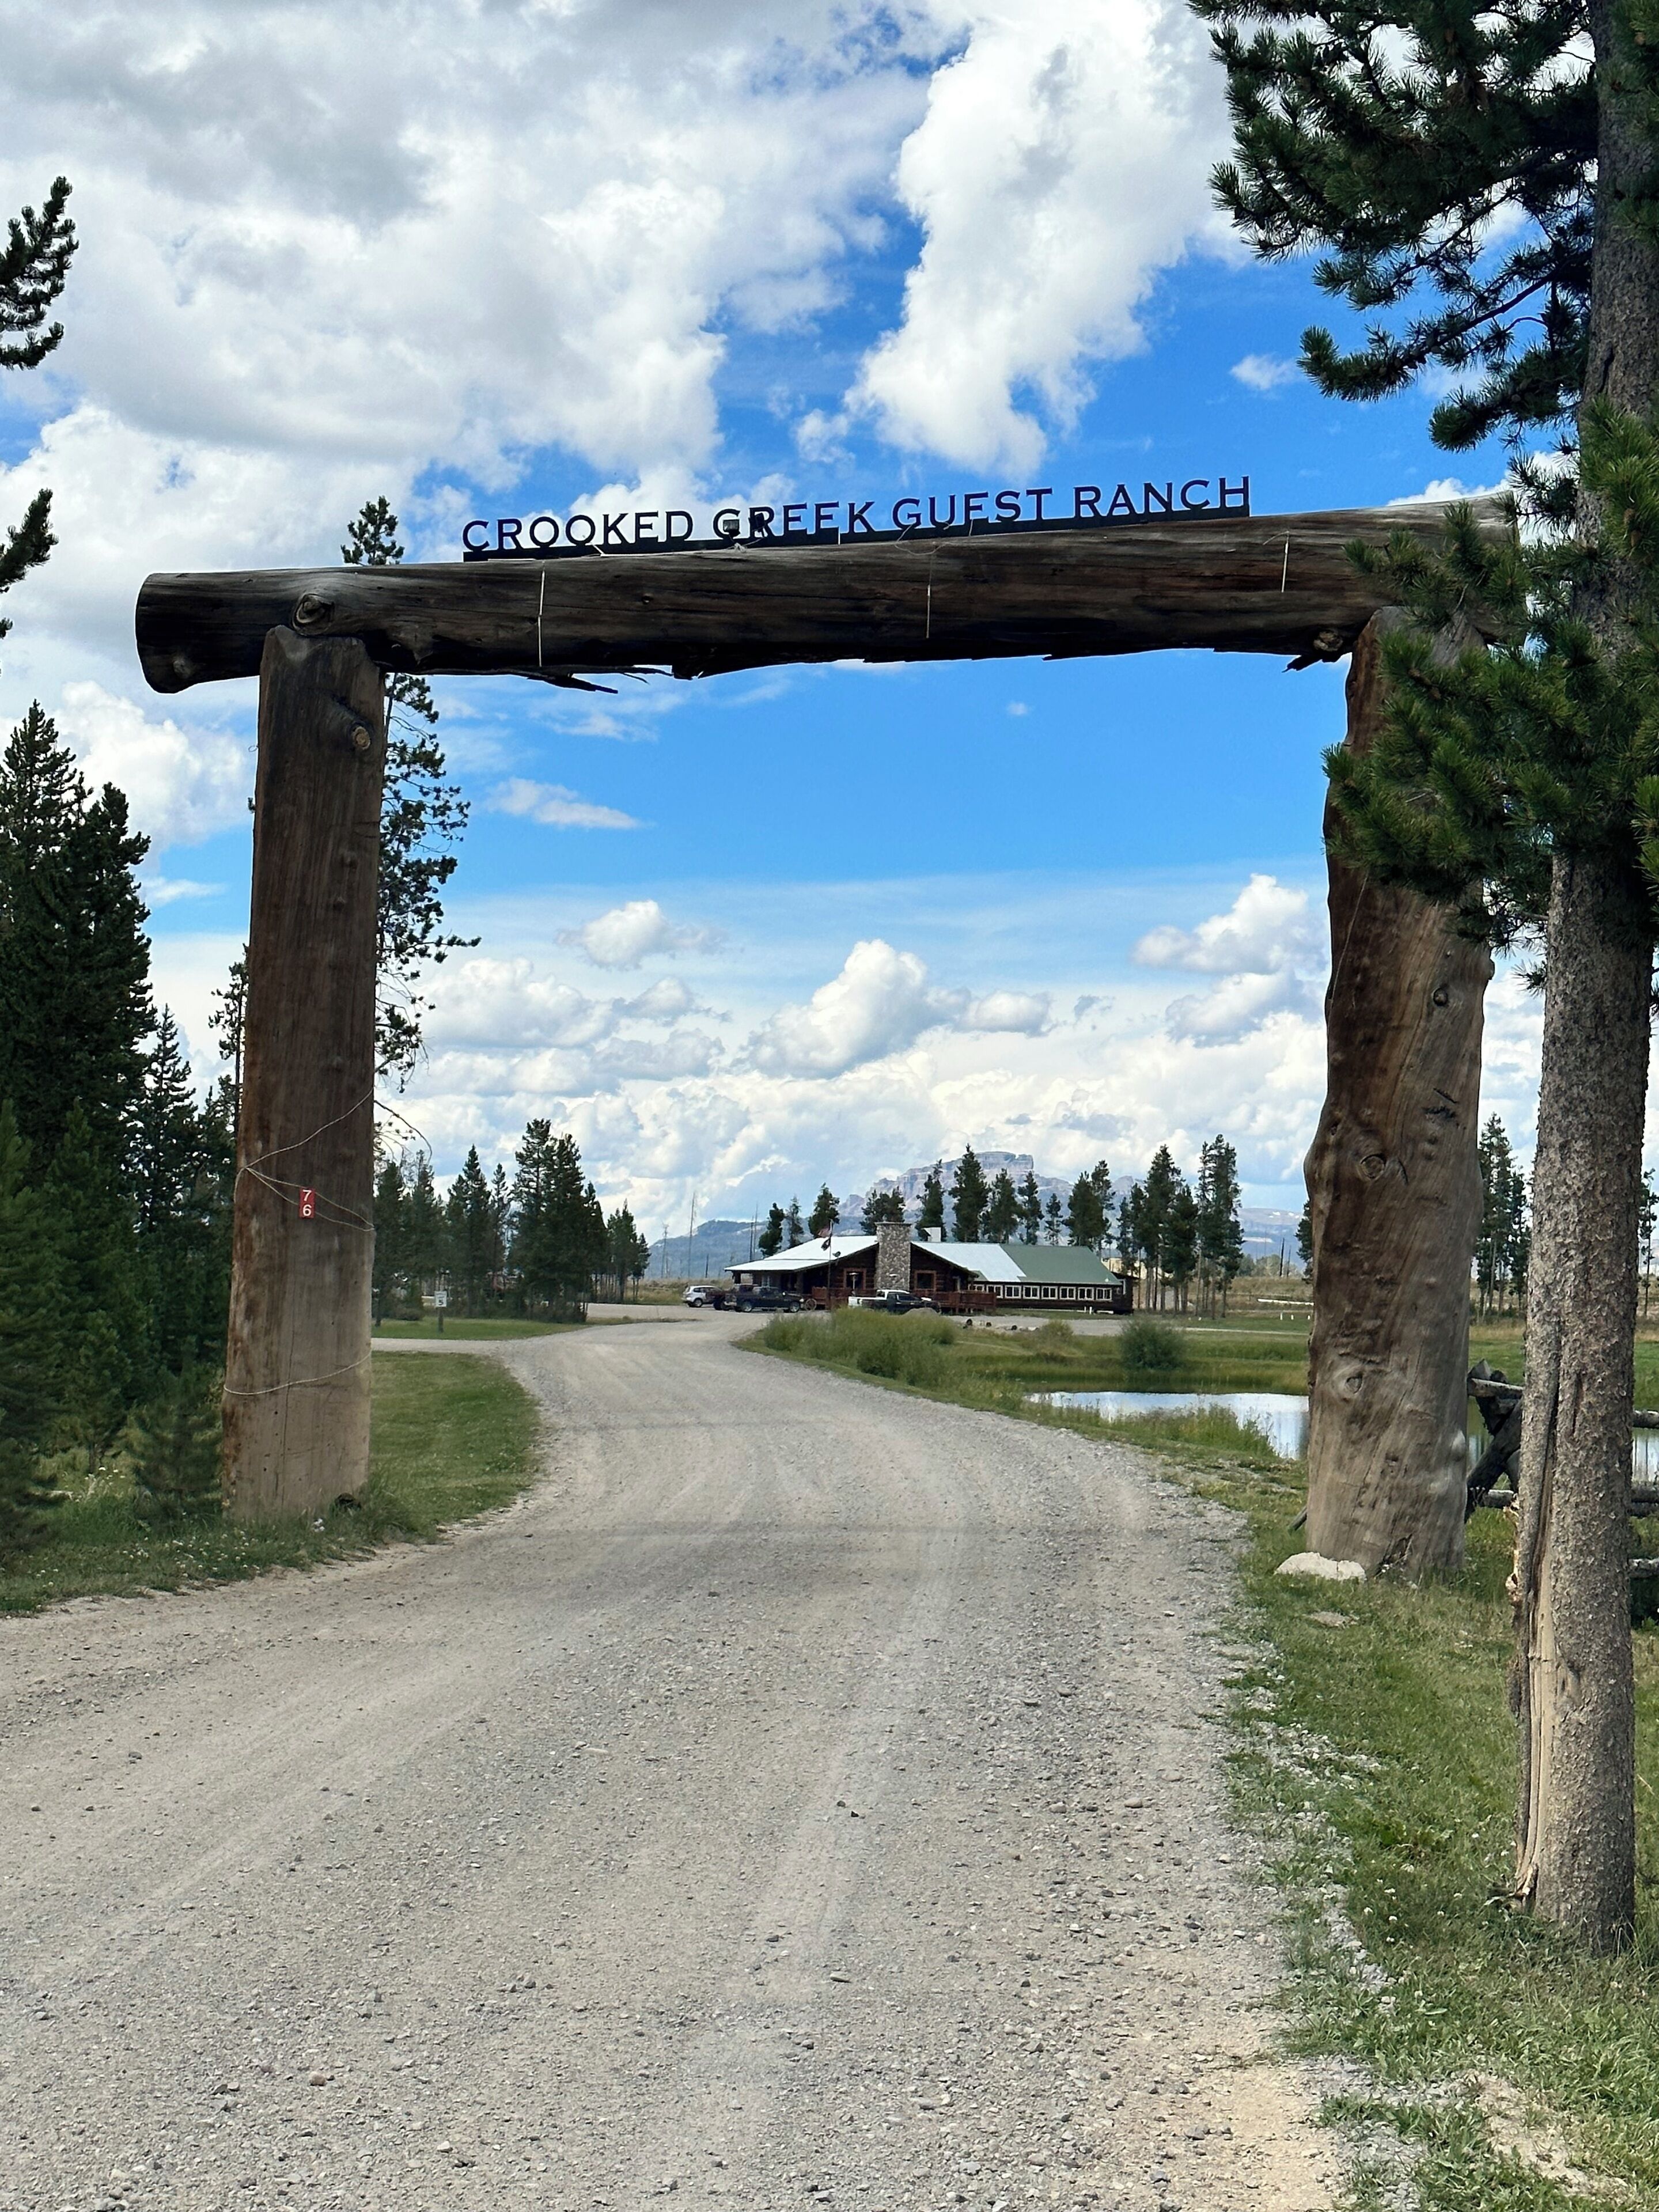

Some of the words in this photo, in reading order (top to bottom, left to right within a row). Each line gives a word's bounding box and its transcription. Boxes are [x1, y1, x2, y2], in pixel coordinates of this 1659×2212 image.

[463, 510, 692, 551] CROOKED
[893, 487, 1052, 530] GUEST
[1073, 476, 1249, 518] RANCH
